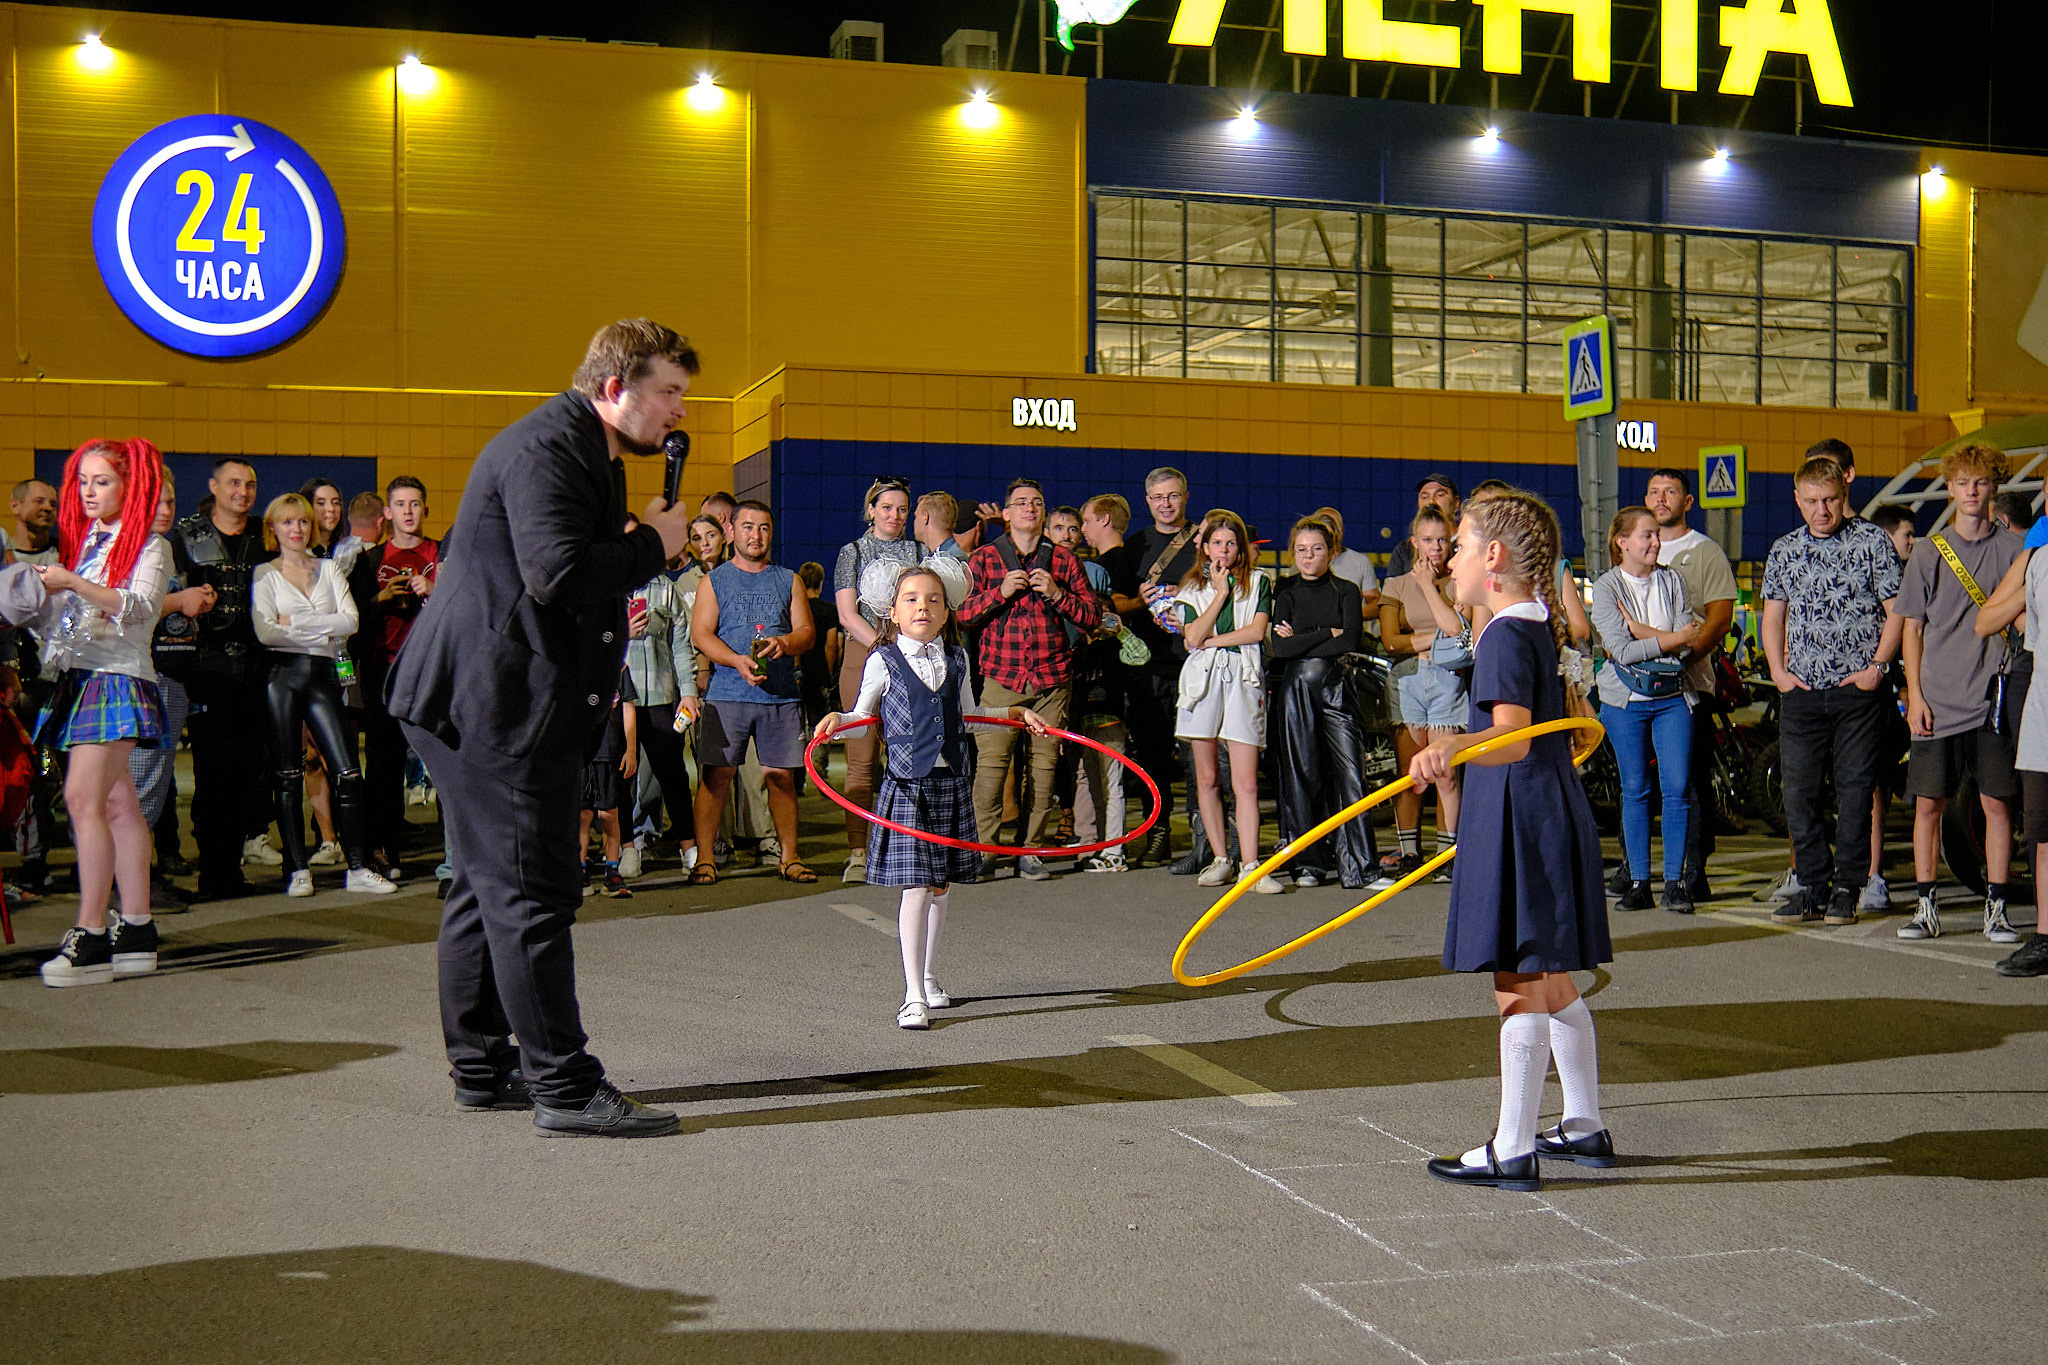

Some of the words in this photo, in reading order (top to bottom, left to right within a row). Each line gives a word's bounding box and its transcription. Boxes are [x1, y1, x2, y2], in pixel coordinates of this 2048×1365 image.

[175, 169, 266, 254] 24
[175, 260, 265, 301] ЧАСА
[1012, 397, 1077, 432] ВХОД
[1616, 420, 1657, 453] ХОД
[1938, 543, 1956, 562] STAY
